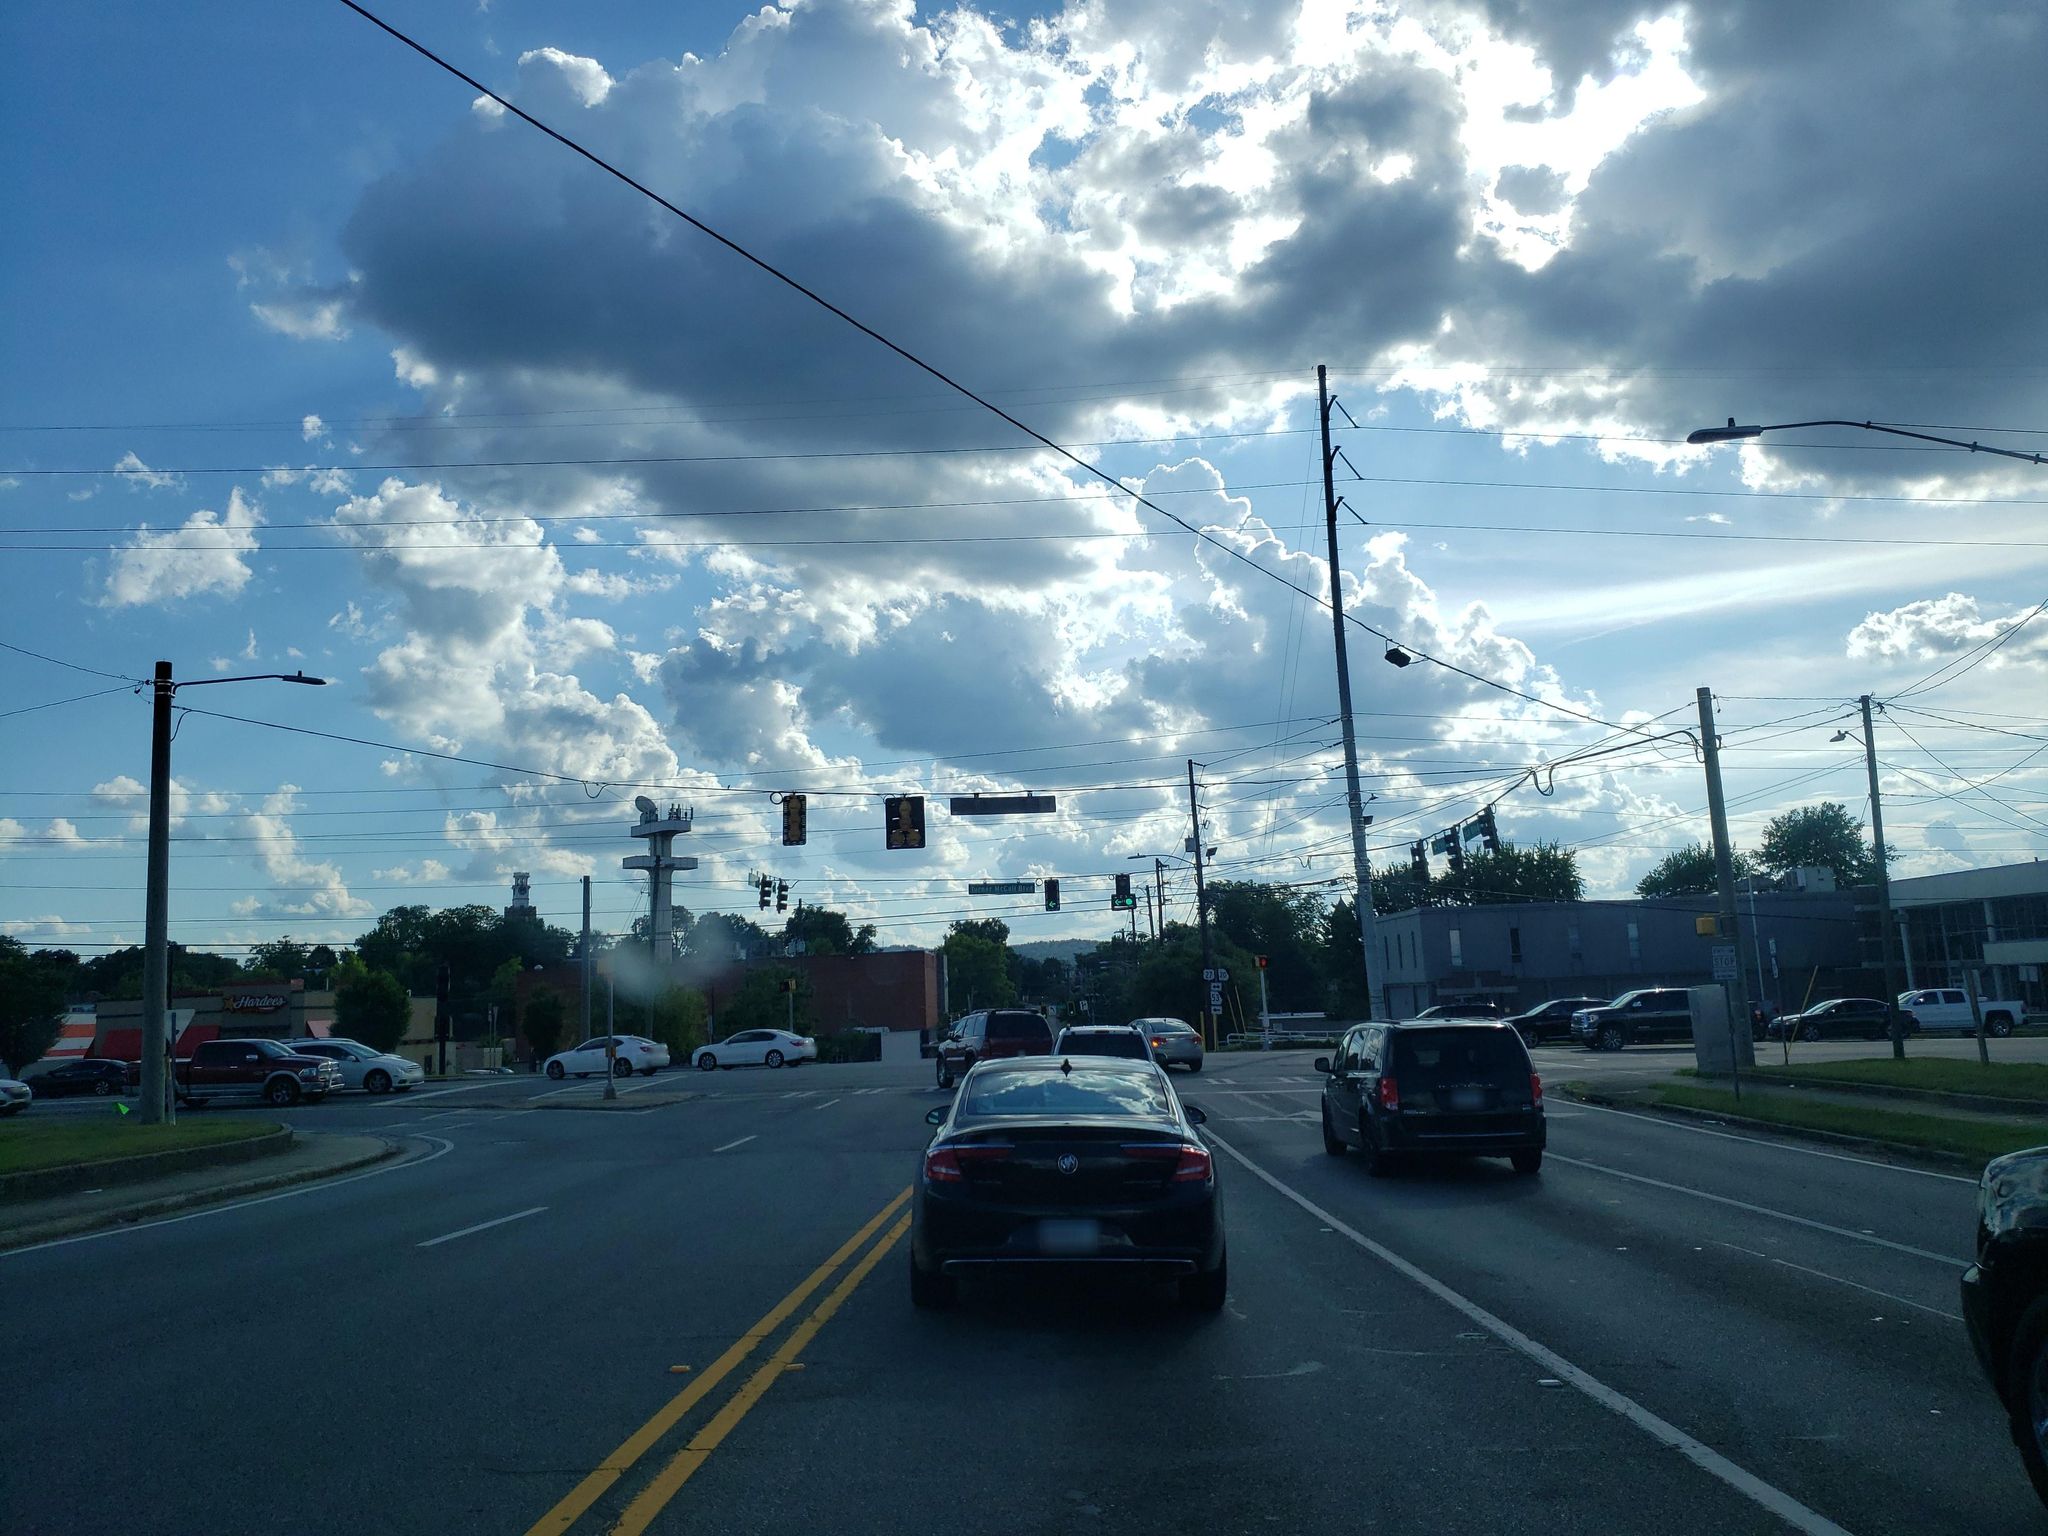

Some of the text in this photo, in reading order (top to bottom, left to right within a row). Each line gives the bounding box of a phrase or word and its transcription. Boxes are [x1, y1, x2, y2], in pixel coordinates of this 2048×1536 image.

[1714, 958, 1735, 967] STOP
[1205, 971, 1213, 979] 27
[1211, 993, 1220, 1002] 53
